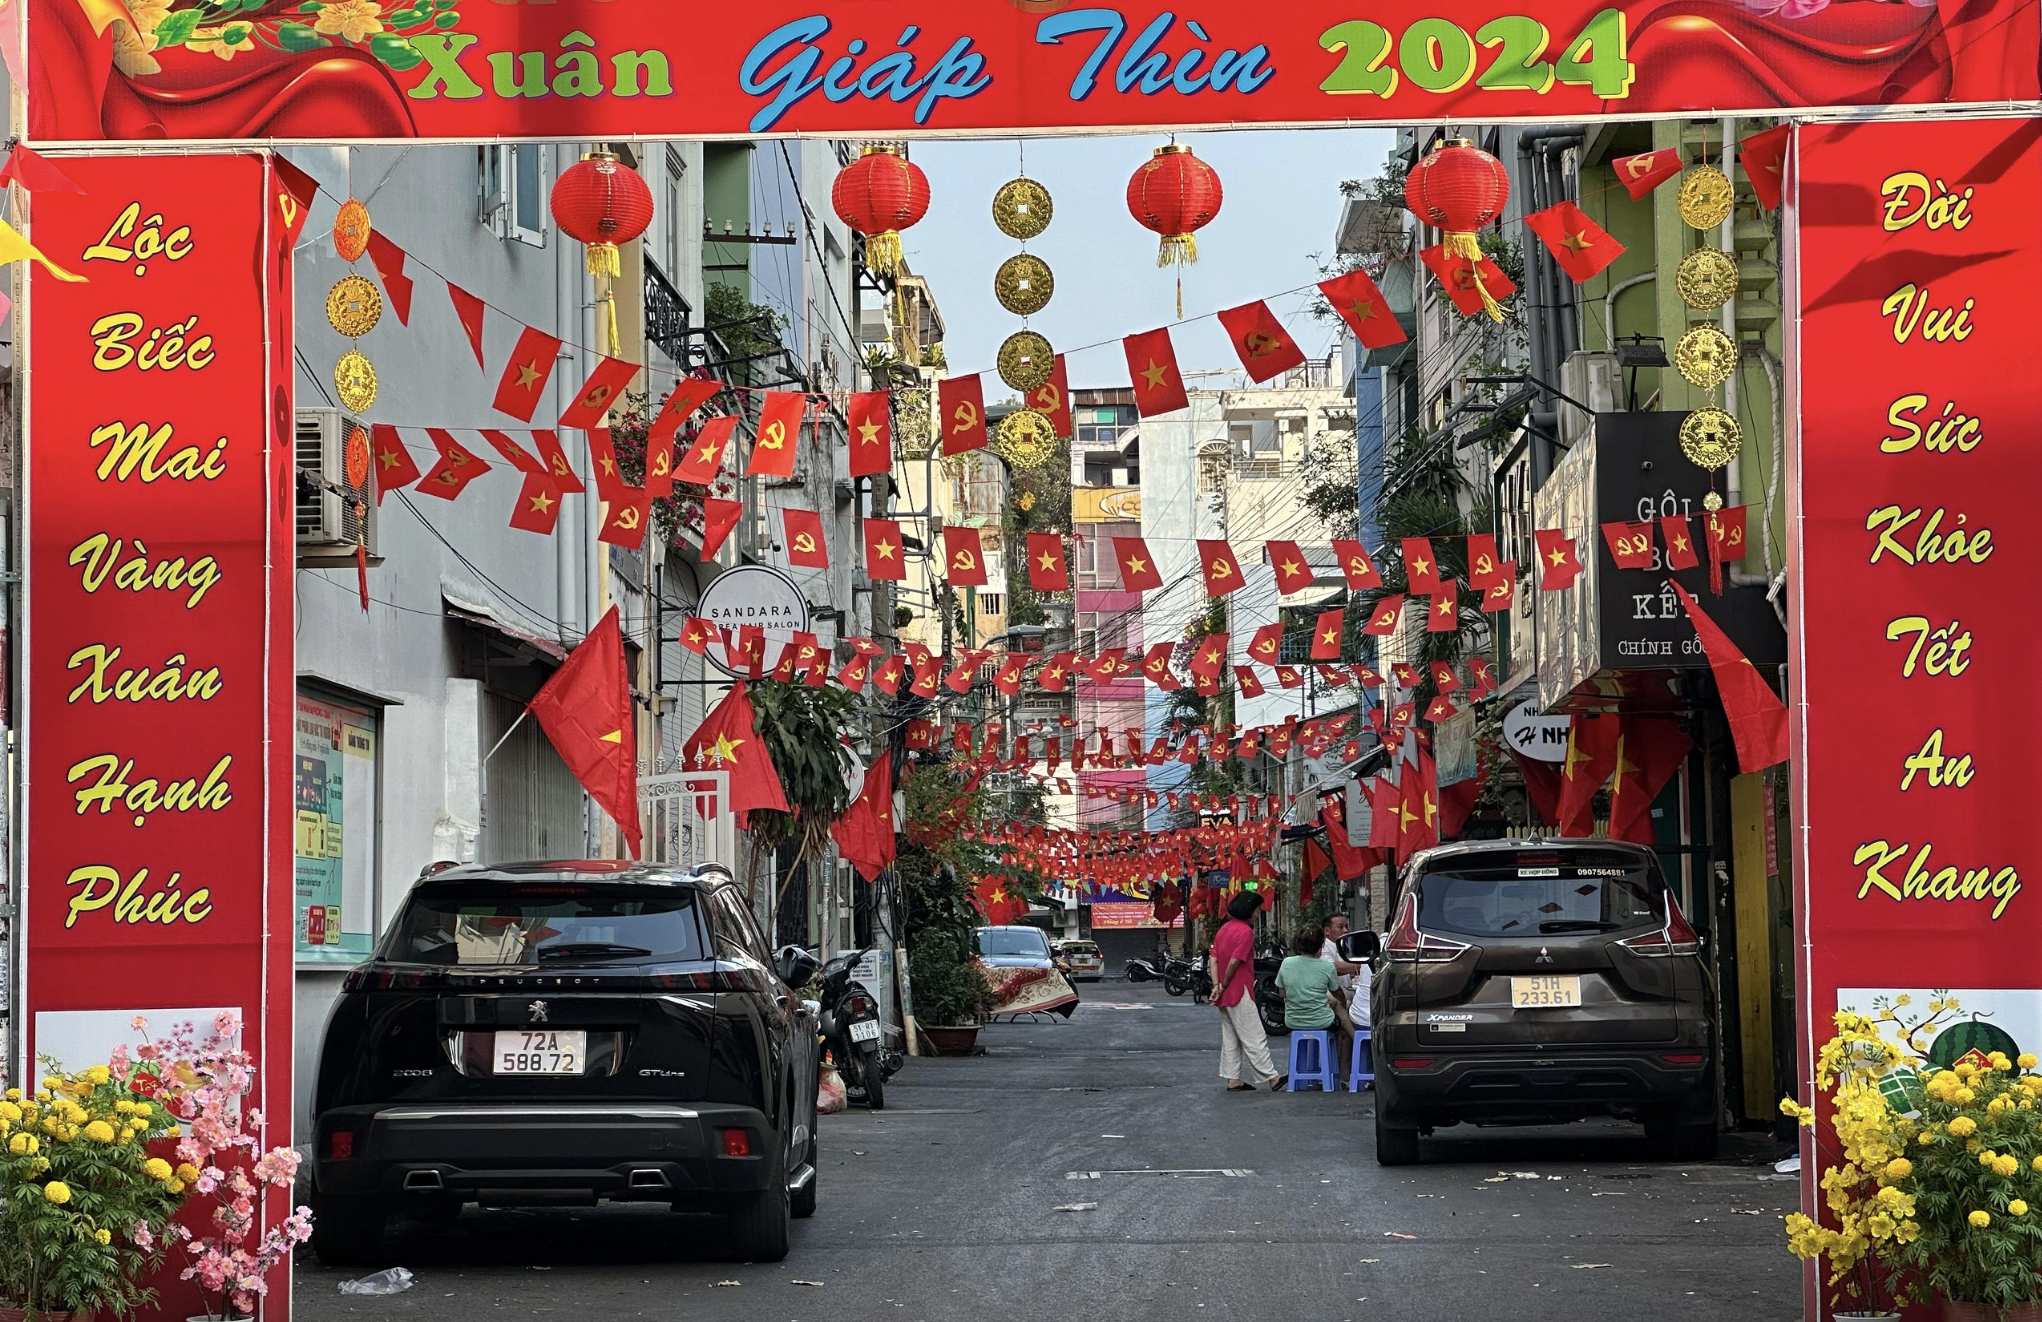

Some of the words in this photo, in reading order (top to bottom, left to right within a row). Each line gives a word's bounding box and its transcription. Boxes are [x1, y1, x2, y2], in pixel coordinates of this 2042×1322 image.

[408, 29, 674, 99] Xuân
[739, 14, 992, 133] Giáp
[1036, 8, 1275, 102] Thìn
[1318, 8, 1637, 100] 2024
[1880, 171, 1974, 232] Đời
[81, 200, 195, 278] Lộc
[88, 311, 215, 372] Biếc
[1881, 283, 1975, 345] Vui
[88, 420, 228, 484] Mai
[1879, 393, 1982, 454] Sức
[1864, 504, 1993, 565] Khỏe
[68, 532, 223, 609] Vàng
[711, 605, 792, 618] SANDARA
[767, 620, 800, 629] SALON
[67, 643, 223, 705] Xuân
[1617, 637, 1673, 656] CHÍNH
[1681, 633, 1707, 655] GỐ
[1885, 615, 1973, 678] Tết
[1524, 706, 1539, 717] NH
[1542, 727, 1570, 745] NH
[1899, 728, 1976, 791] An
[66, 753, 233, 828] Hạnh
[64, 864, 213, 929] Phúc
[1577, 868, 1626, 877] 0907564881
[1852, 839, 2021, 921] Khang
[1520, 990, 1572, 1006] 233.61
[1531, 976, 1560, 990] 51H
[520, 1032, 559, 1051] 72A
[1426, 1014, 1473, 1022] XPANDER
[503, 1053, 575, 1072] 588.72
